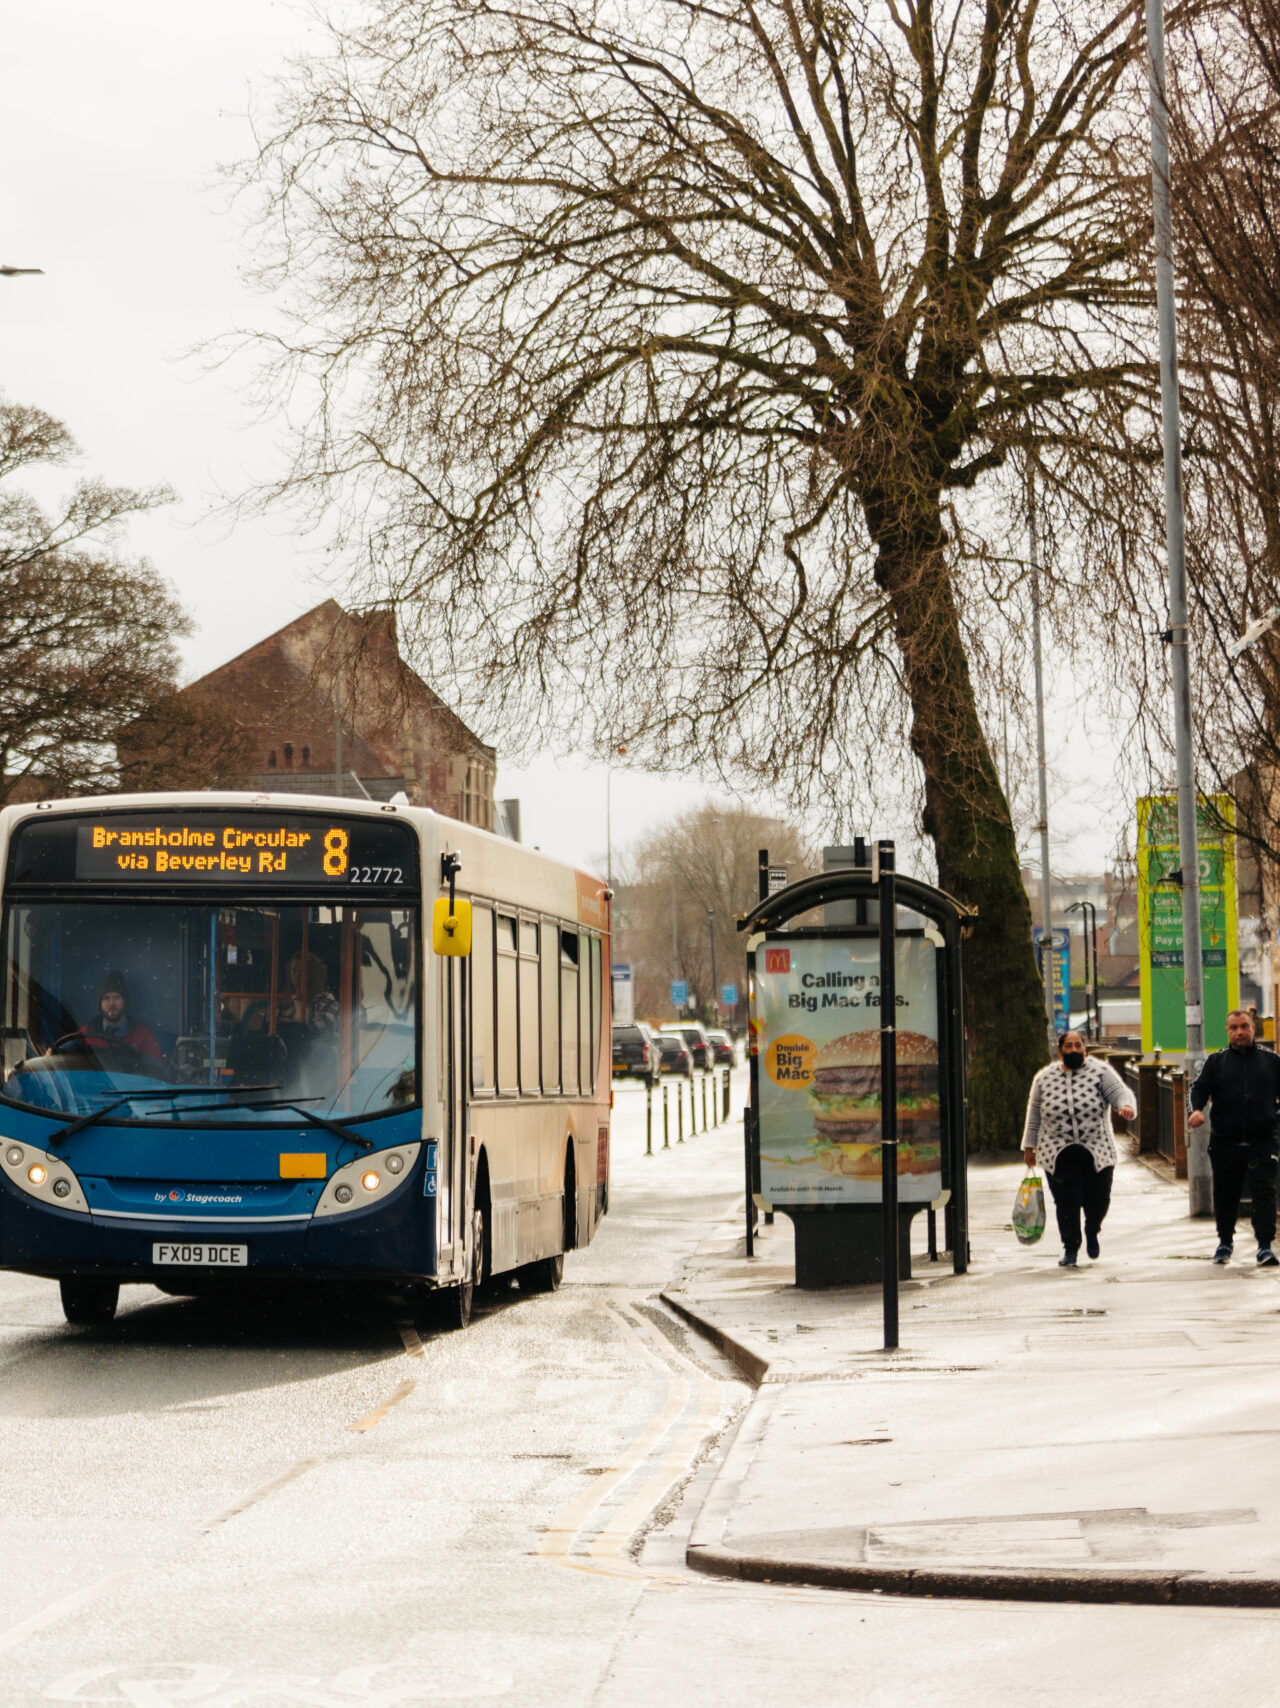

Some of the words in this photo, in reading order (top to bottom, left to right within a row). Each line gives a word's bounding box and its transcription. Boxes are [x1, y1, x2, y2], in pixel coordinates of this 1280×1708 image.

[92, 826, 216, 848] Bransholme
[222, 827, 311, 849] Circular
[322, 827, 348, 876] 8
[117, 852, 149, 870] via
[155, 851, 252, 872] Beverley
[258, 852, 287, 873] Rd
[350, 867, 404, 884] 22772
[1154, 916, 1183, 926] Baker
[1155, 936, 1174, 945] Pay
[801, 971, 866, 990] Calling
[788, 992, 818, 1012] Big
[821, 993, 860, 1008] Mac
[864, 992, 910, 1008] fas.
[776, 1052, 803, 1069] Big
[776, 1068, 810, 1080] Mac
[154, 1192, 167, 1203] by
[185, 1193, 242, 1203] Stagecoach
[158, 1246, 203, 1262] FX09
[207, 1246, 241, 1264] DCE
